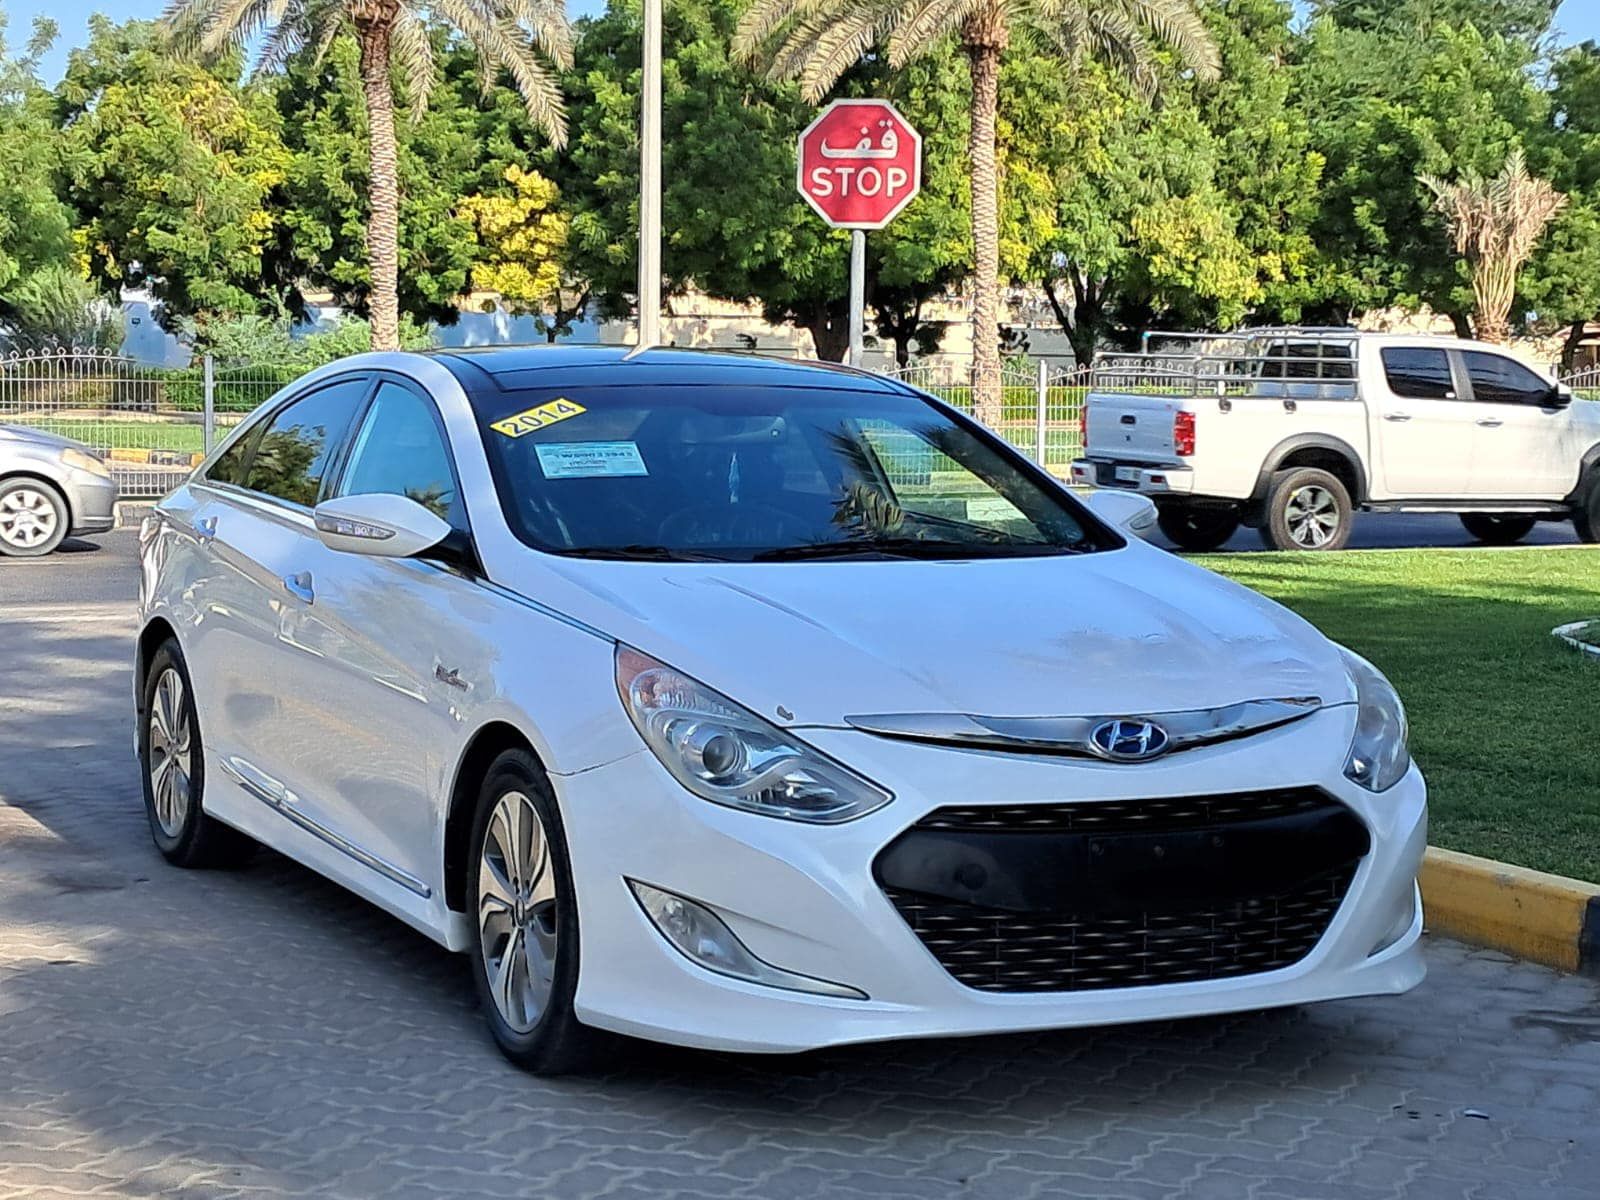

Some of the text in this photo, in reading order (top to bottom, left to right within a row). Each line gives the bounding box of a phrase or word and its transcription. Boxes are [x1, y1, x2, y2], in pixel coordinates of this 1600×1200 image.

[821, 119, 898, 159] قف
[811, 166, 908, 197] STOP
[501, 402, 577, 434] 2014
